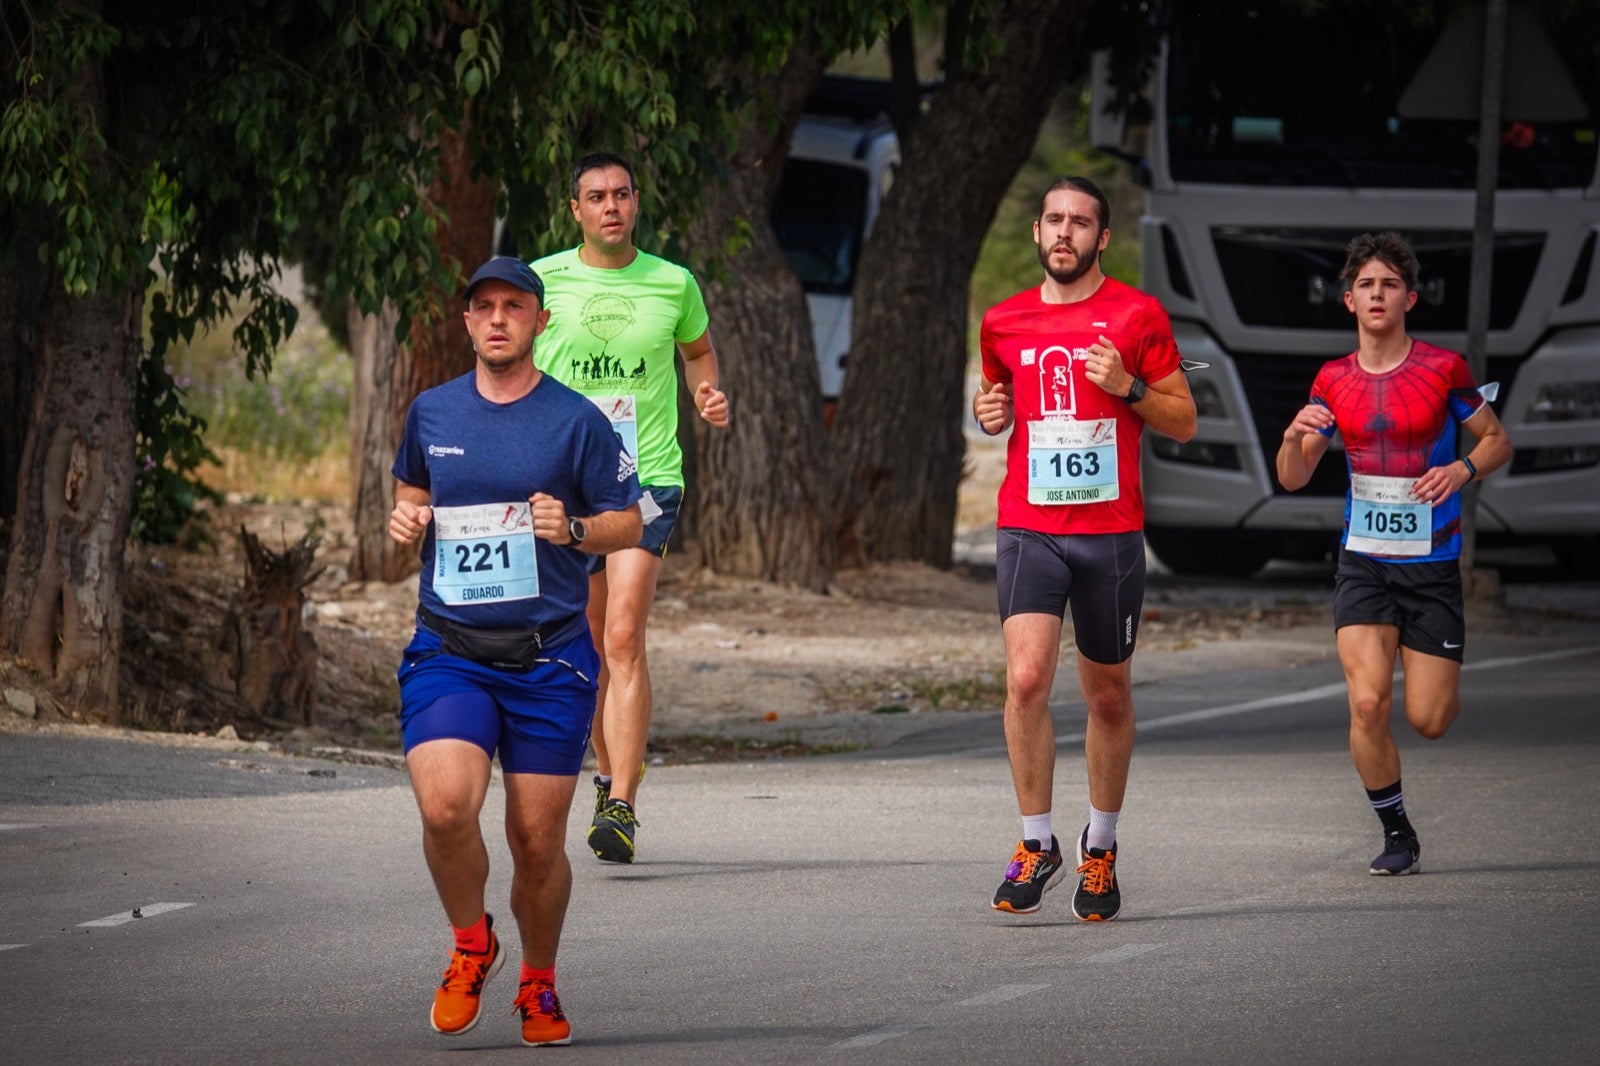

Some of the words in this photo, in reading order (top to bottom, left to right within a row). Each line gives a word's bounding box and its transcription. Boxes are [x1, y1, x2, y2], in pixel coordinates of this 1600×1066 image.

[617, 463, 638, 482] adida
[1050, 451, 1100, 478] 163
[1046, 490, 1063, 502] JOSE
[1065, 488, 1100, 501] ANTONIO
[1364, 510, 1418, 534] 1053
[455, 540, 510, 573] 221
[462, 585, 504, 601] EDUARDO
